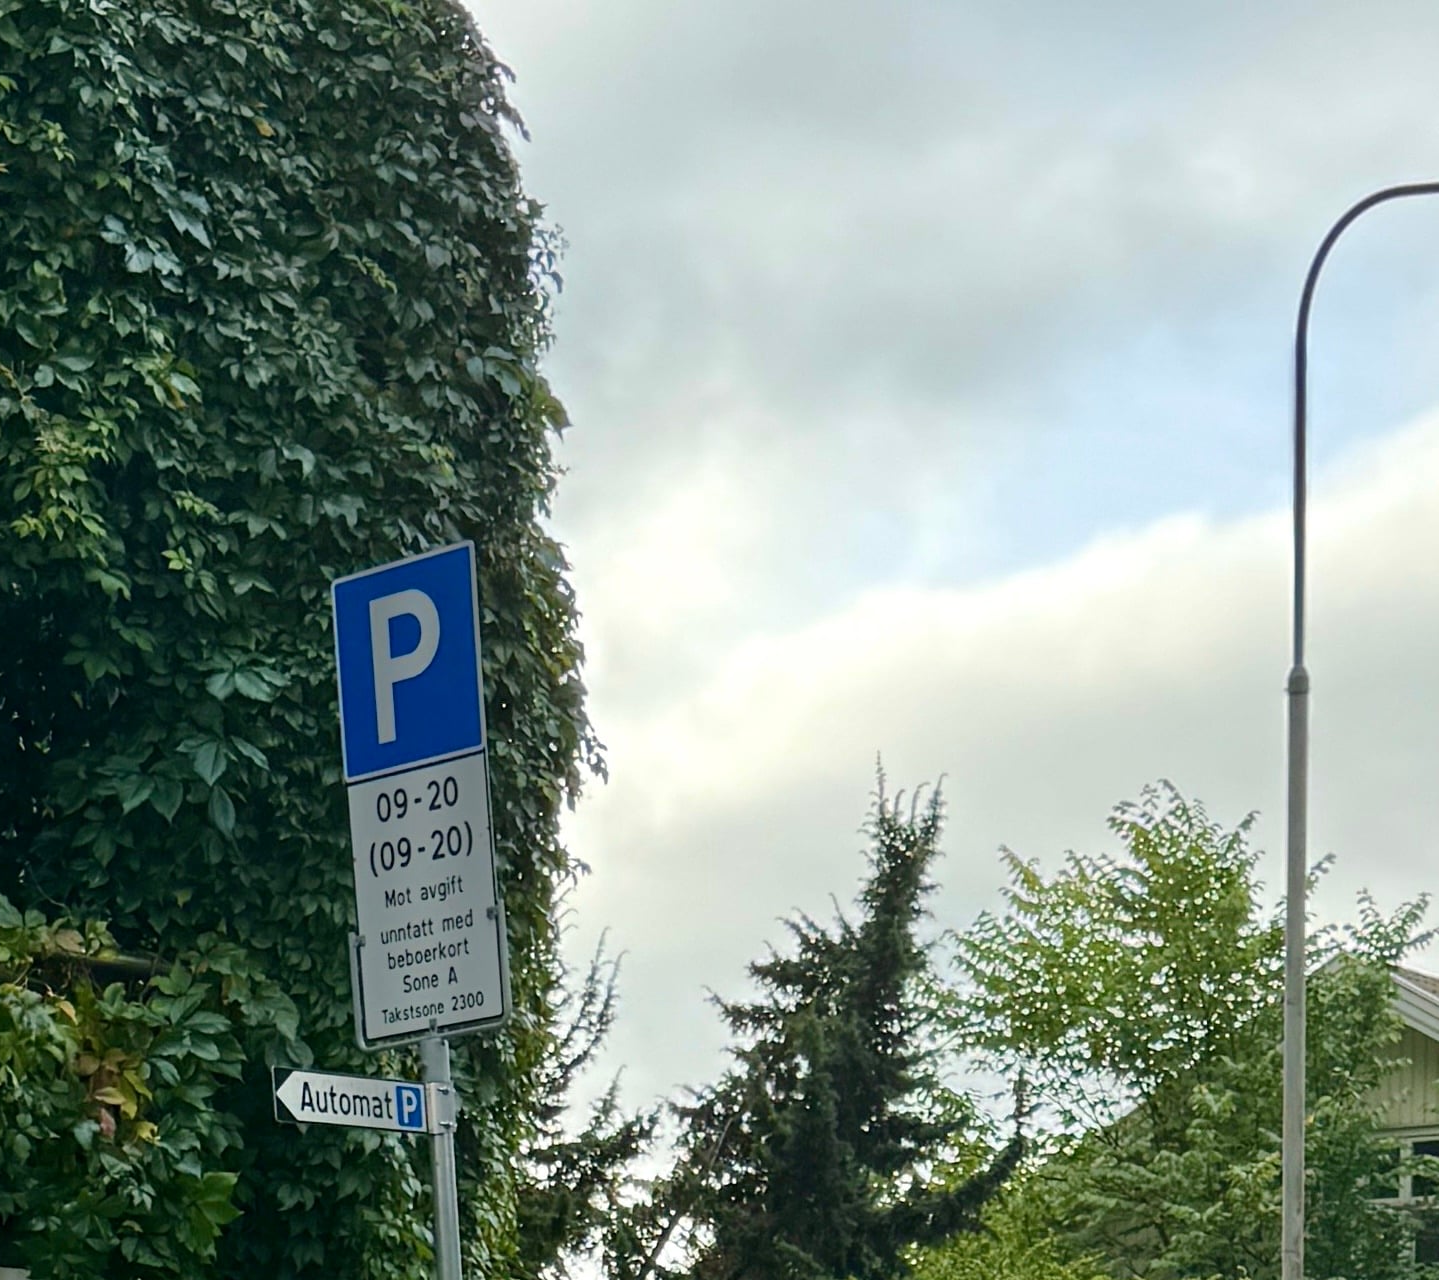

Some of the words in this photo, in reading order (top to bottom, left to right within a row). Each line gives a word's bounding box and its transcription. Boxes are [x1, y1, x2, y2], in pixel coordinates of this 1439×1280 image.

[369, 588, 441, 745] P
[385, 888, 411, 908] Mot
[421, 875, 464, 901] avgift
[380, 918, 434, 945] unntatt
[442, 908, 474, 932] med
[387, 938, 470, 970] beboerkort
[403, 973, 439, 993] Sone
[448, 966, 458, 985] A
[381, 1002, 445, 1024] Takstsone
[451, 991, 485, 1011] 2300
[300, 1081, 393, 1120] Automat
[401, 1088, 418, 1124] P
